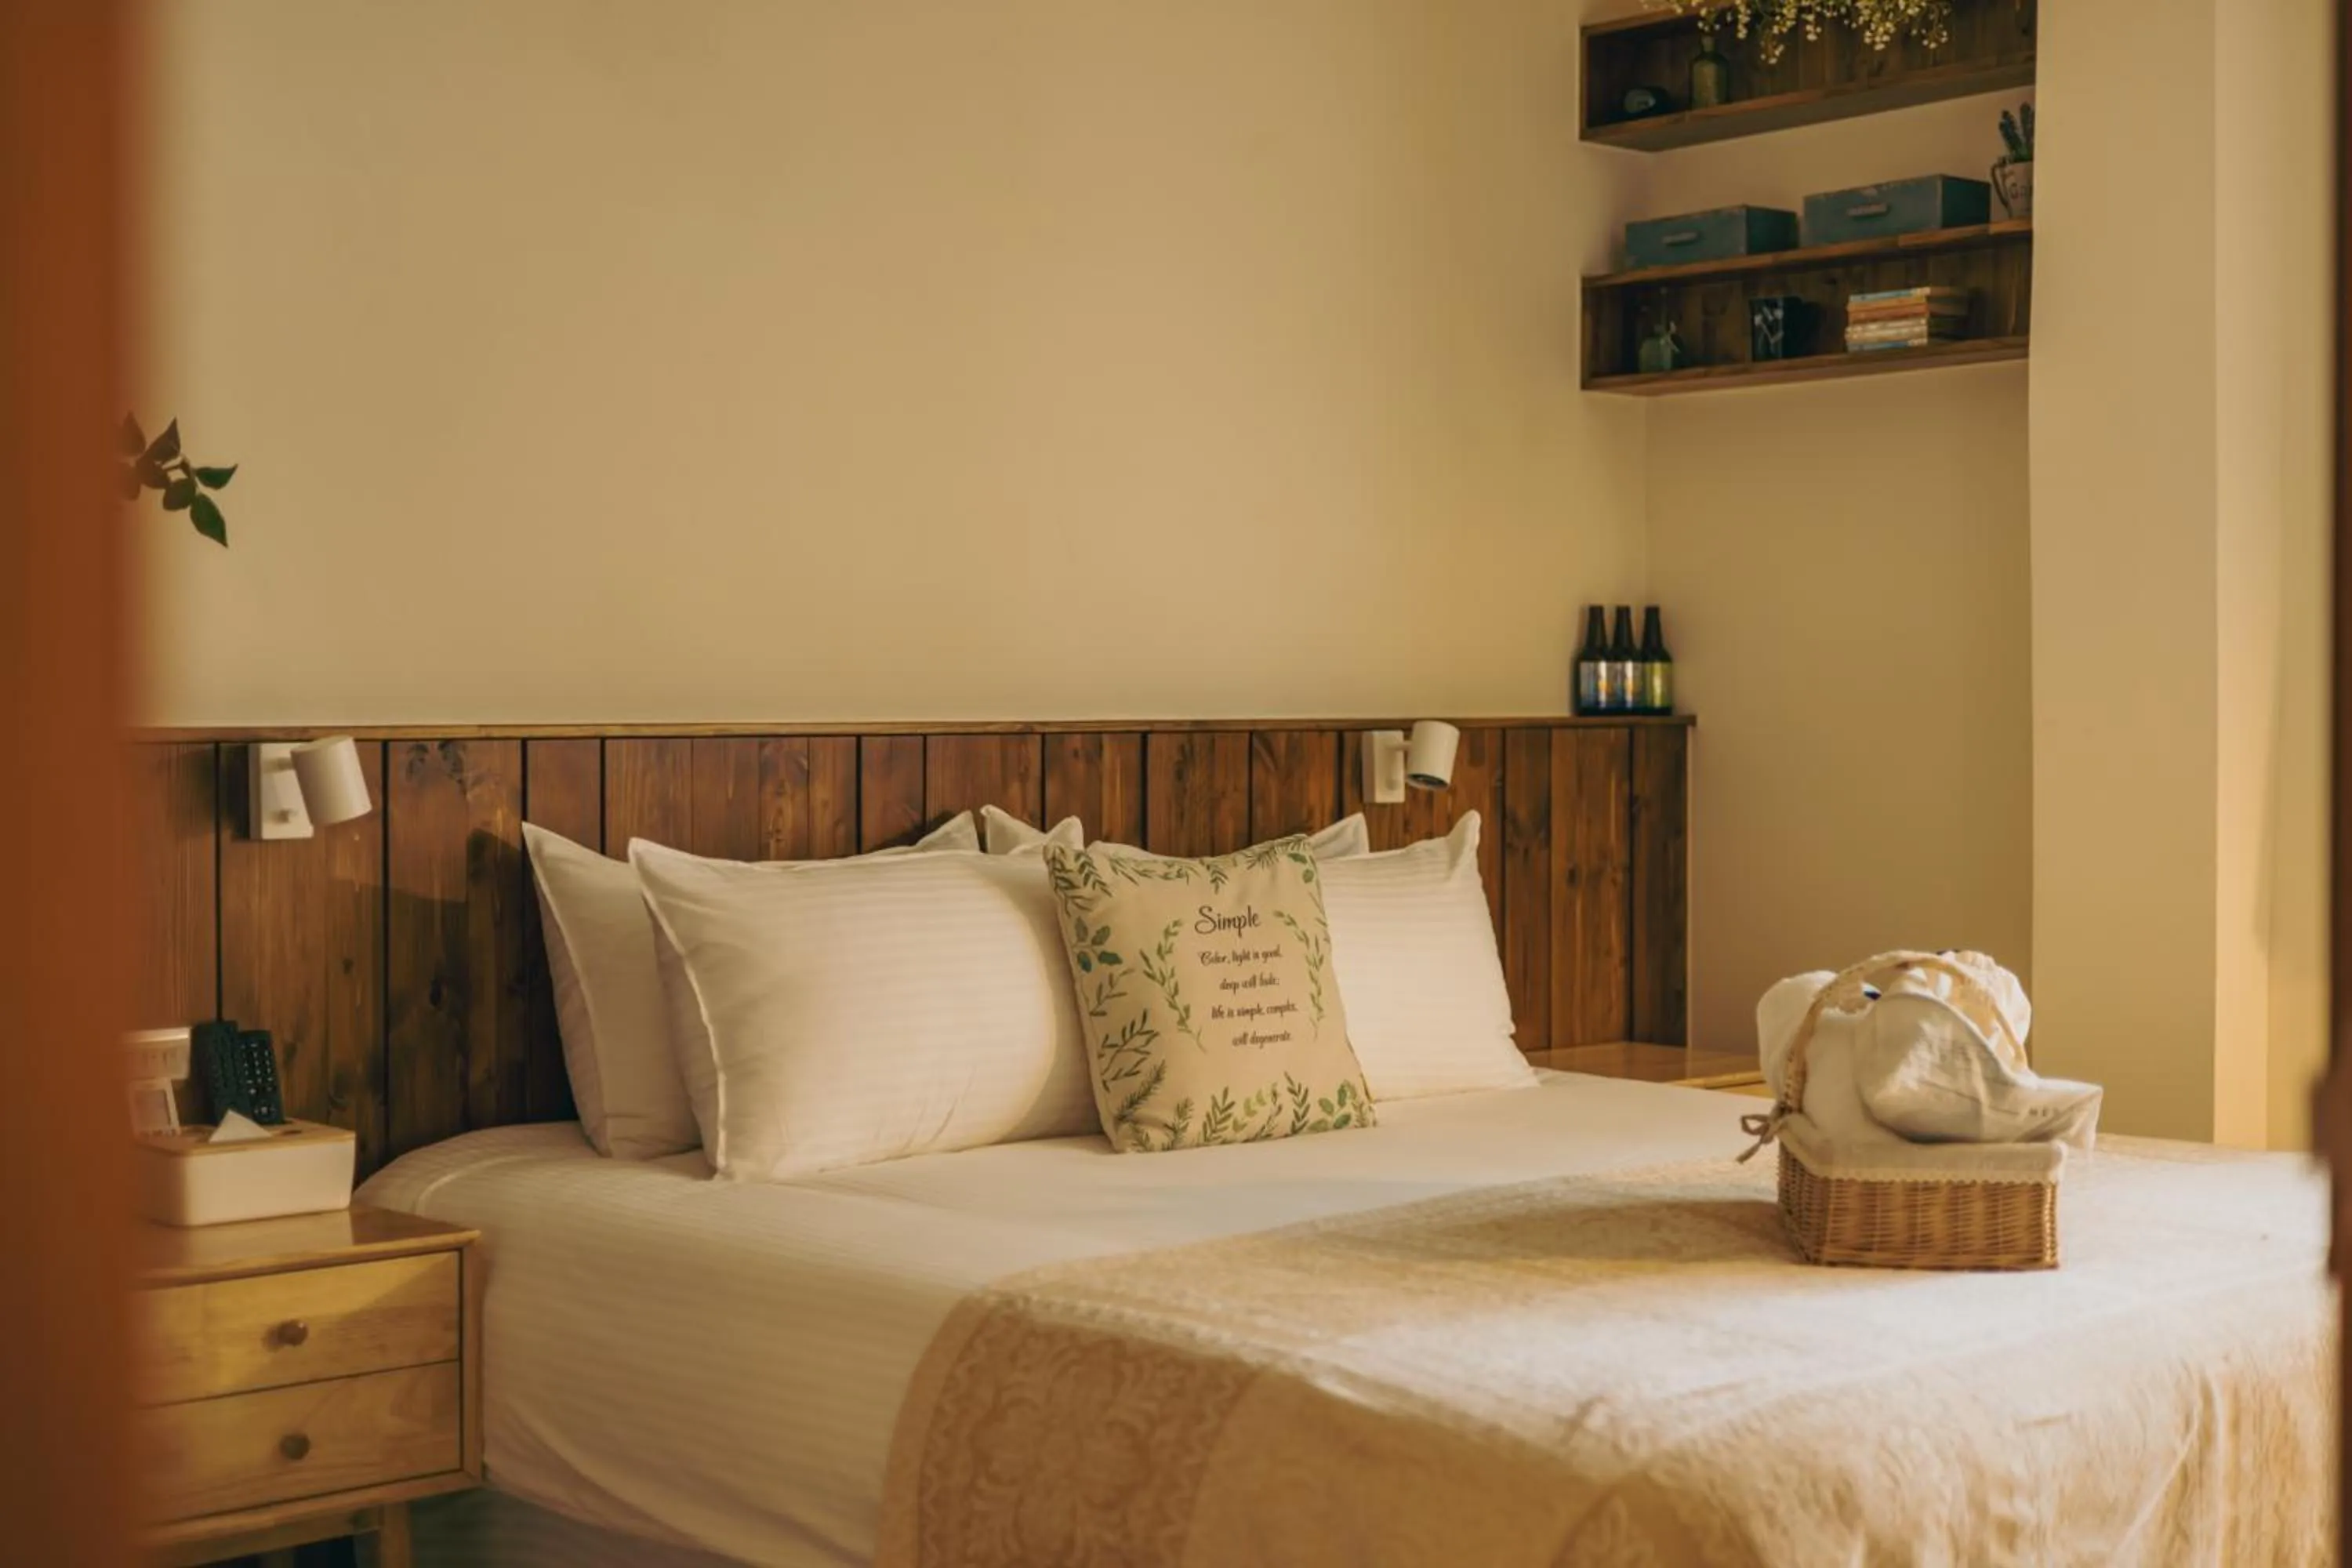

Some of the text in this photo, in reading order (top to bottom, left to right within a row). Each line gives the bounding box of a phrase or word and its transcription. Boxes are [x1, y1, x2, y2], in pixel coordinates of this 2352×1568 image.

[1194, 906, 1260, 938] Simple
[1232, 948, 1250, 966] light
[1219, 978, 1240, 995] deep
[1211, 1004, 1224, 1019] life
[1227, 1007, 1234, 1018] is
[1232, 1032, 1248, 1047] will
